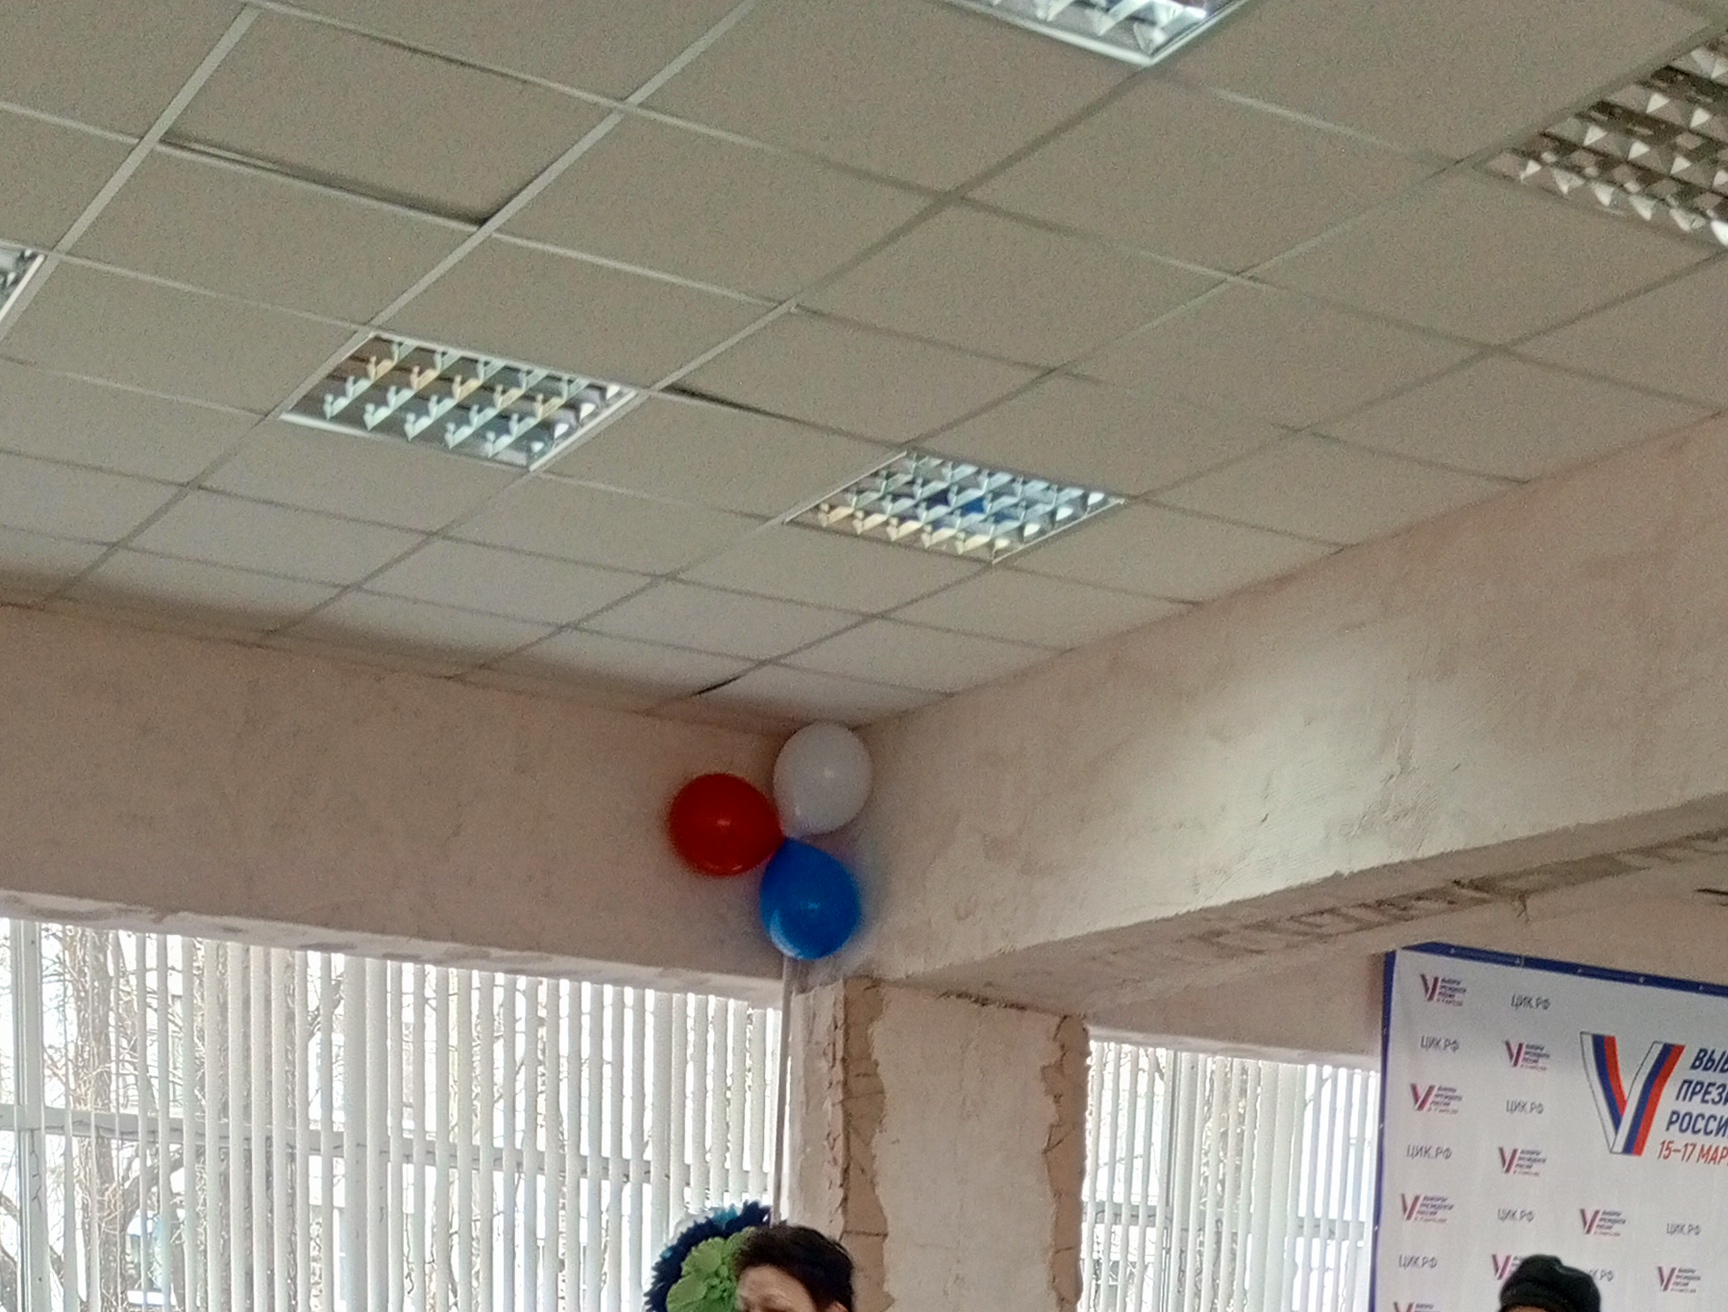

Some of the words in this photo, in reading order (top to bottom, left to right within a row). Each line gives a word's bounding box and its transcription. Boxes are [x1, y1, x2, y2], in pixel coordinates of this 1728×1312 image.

[1675, 1079, 1728, 1106] ПРЕЗ
[1506, 1099, 1545, 1115] ЦИК.РФ
[1406, 1144, 1453, 1160] ЦИК.РФ
